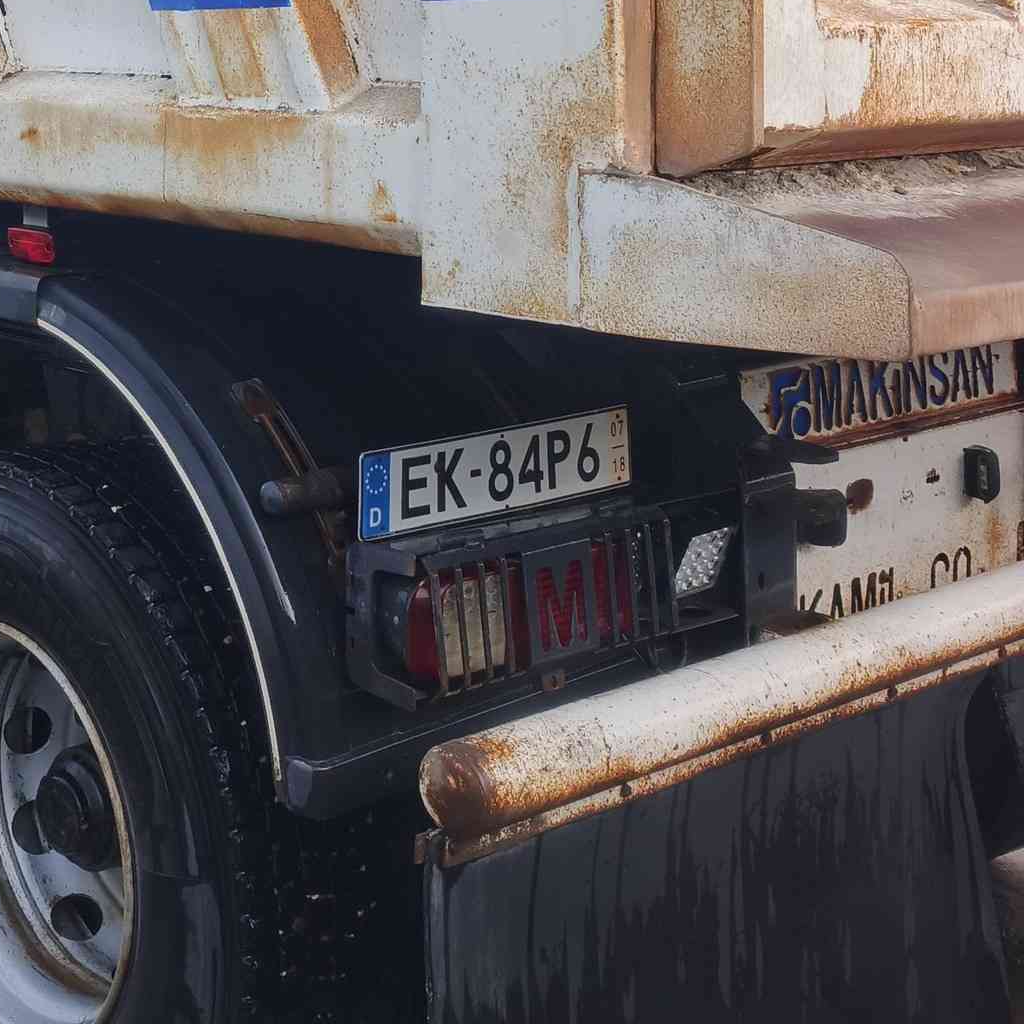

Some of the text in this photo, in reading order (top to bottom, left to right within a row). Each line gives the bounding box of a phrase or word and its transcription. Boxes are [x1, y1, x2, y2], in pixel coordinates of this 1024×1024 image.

[609, 420, 625, 437] 07
[401, 422, 601, 520] EK-84P6
[369, 507, 382, 528] D
